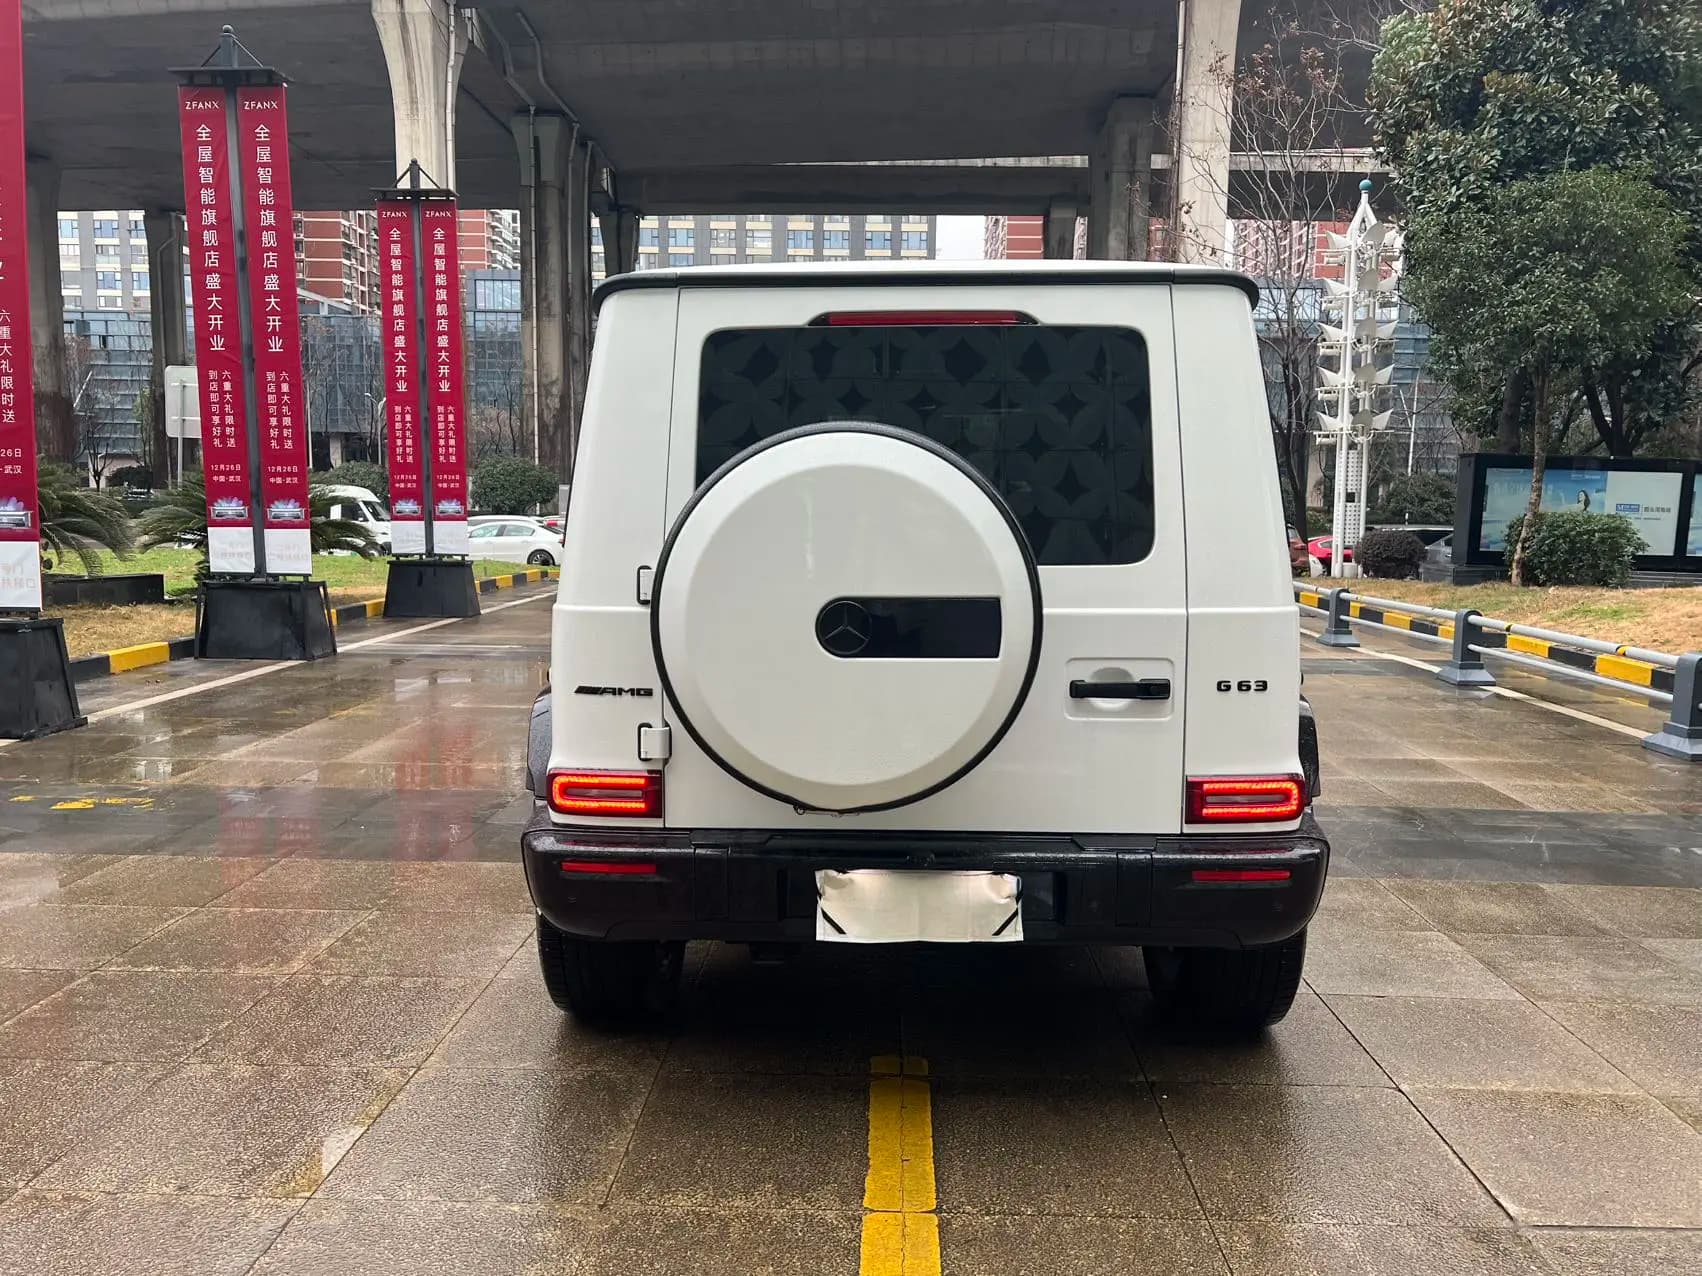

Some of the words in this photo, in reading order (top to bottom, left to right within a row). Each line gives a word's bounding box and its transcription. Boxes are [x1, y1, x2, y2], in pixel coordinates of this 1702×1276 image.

[185, 100, 219, 110] ZFANX
[243, 100, 278, 110] ZFANX
[195, 124, 225, 351] 全屋智能旗舰店盛大开业
[254, 124, 284, 352] 全屋智能旗舰店盛大开业
[425, 210, 451, 218] ZFANX
[389, 227, 408, 392] 全屋智能旗舰店盛大开业
[433, 227, 451, 392] 全屋智能旗舰店盛大开业
[208, 370, 223, 448] 到店即可享好礼
[222, 370, 236, 448] 六重大礼限时送
[266, 371, 280, 449] 到店即可享好礼
[279, 371, 293, 450] 六重大礼限时送
[210, 463, 241, 472] 12月26日
[597, 686, 653, 697] AMG
[1216, 680, 1232, 692] G
[1237, 680, 1268, 692] 63
